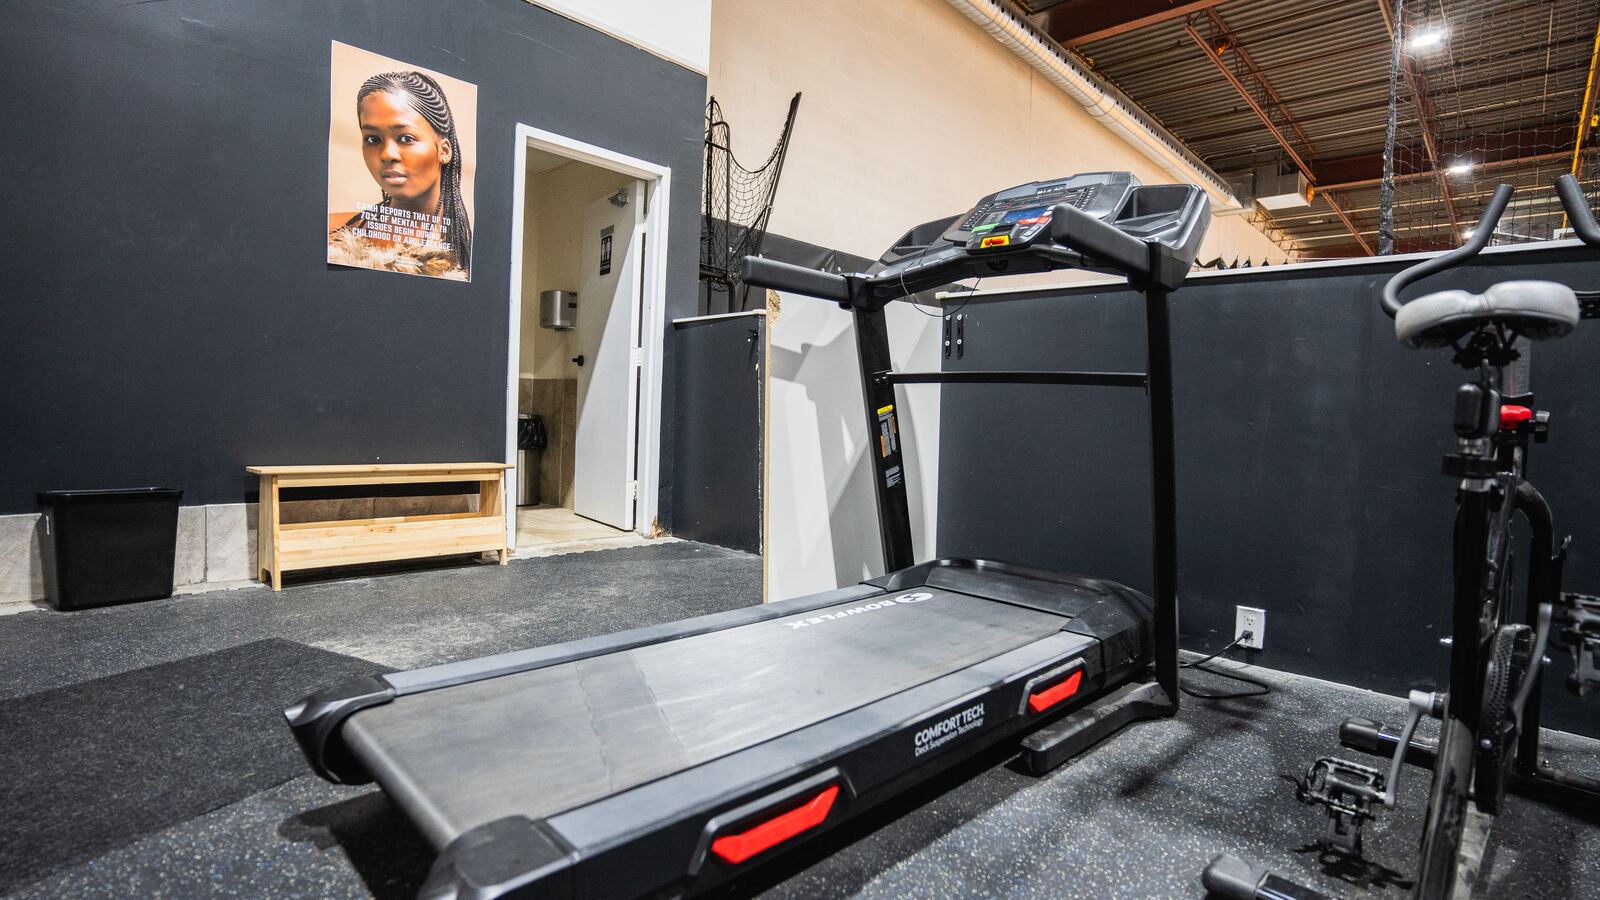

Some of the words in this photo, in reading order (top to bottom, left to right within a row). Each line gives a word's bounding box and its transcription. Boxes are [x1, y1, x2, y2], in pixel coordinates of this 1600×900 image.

[360, 211, 378, 221] 70%
[380, 214, 390, 223] OF
[391, 216, 420, 229] MENTAL
[421, 221, 447, 233] HEALTH
[380, 205, 411, 219] REPORTS
[412, 211, 431, 222] THAT
[431, 215, 441, 224] UP
[442, 217, 451, 226] TO
[352, 227, 391, 240] CHILDHOOD
[392, 234, 402, 243] OR
[367, 220, 393, 232] ISSUES
[394, 225, 414, 236] BEGIN
[416, 229, 441, 241] DURING
[786, 599, 897, 629] BOWFLEX
[914, 713, 961, 746] COMFORT
[962, 702, 985, 723] TECH
[914, 743, 929, 757] Deck
[929, 729, 958, 750] Suspension
[957, 717, 983, 735] Technology
